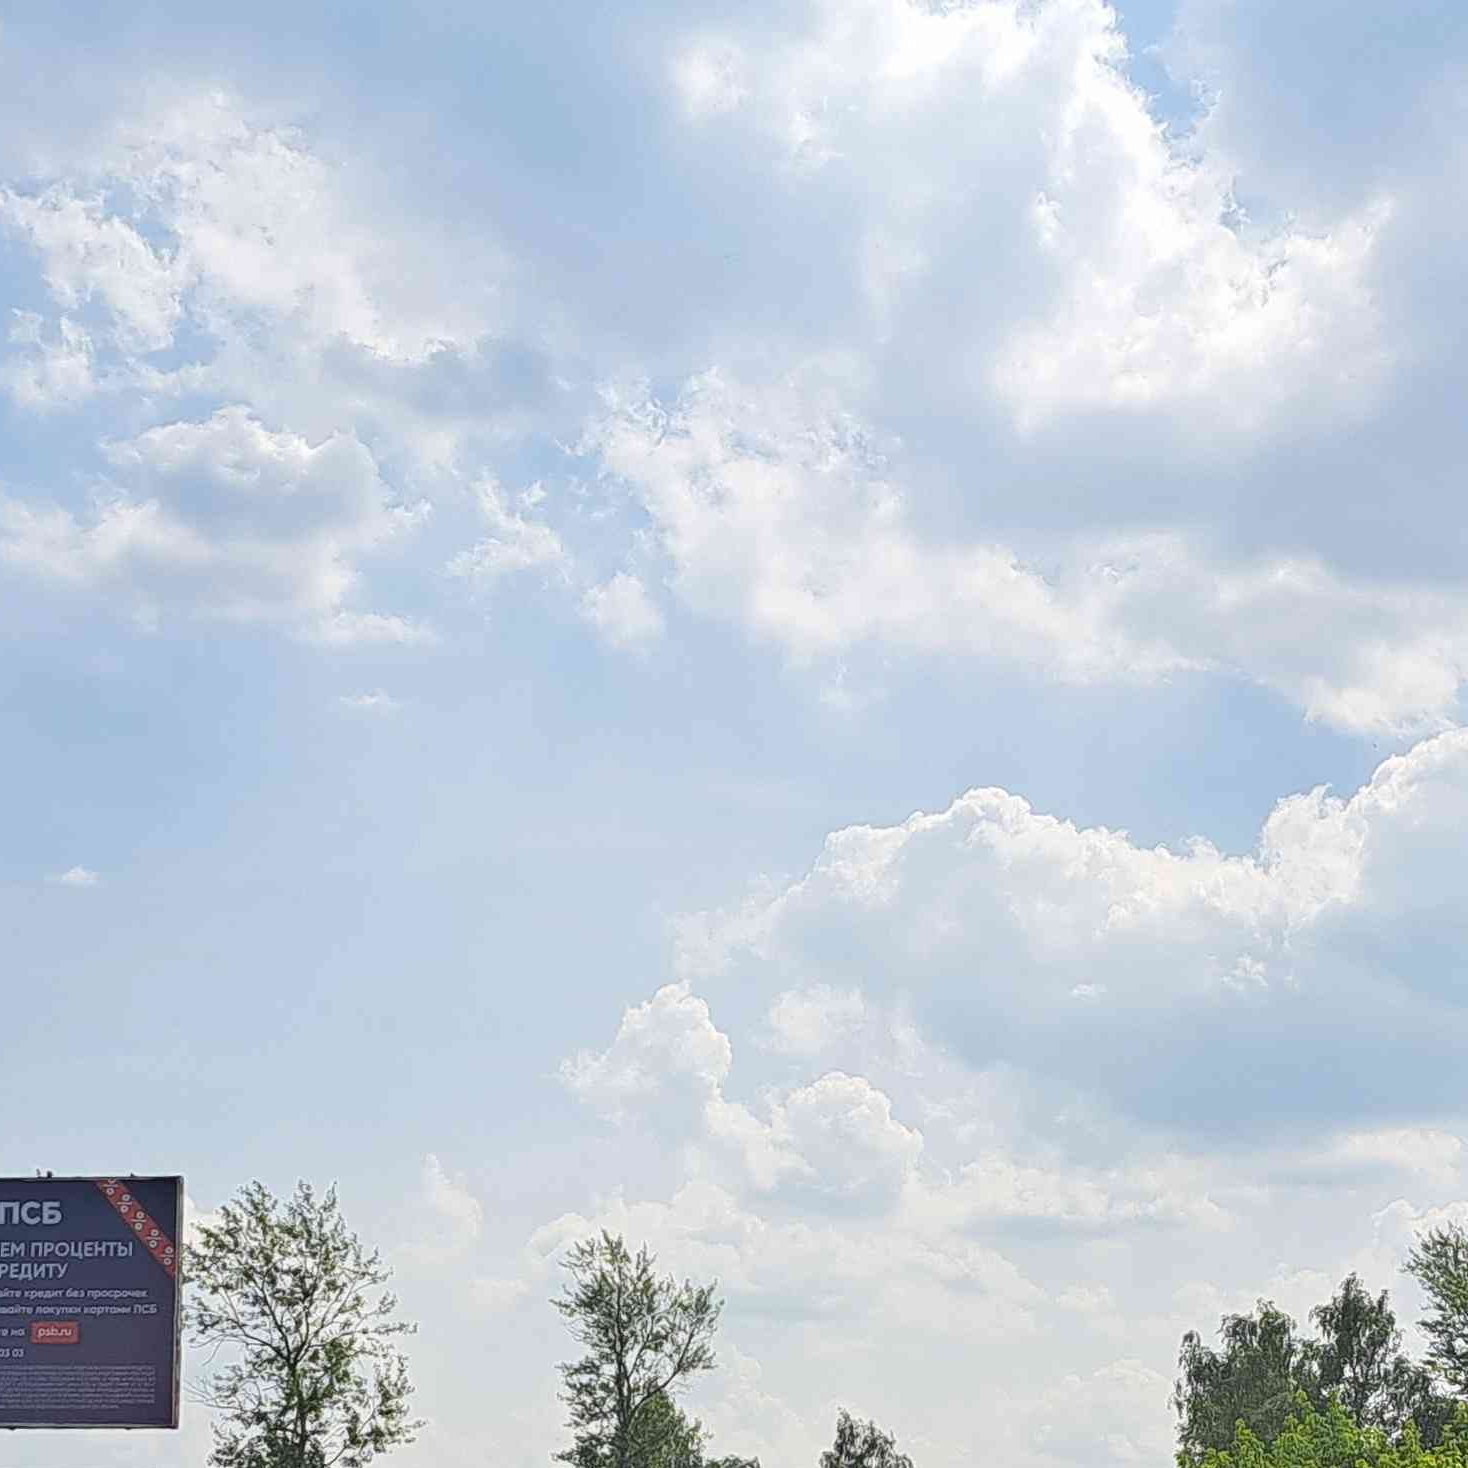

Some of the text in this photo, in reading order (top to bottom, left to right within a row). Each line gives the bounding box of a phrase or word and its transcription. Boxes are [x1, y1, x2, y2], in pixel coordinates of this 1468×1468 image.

[31, 1242, 133, 1260] ПРОЦЕНТЫ
[24, 1289, 63, 1300] кредит
[66, 1288, 85, 1298] без
[133, 1304, 157, 1314] ПСБ
[38, 1326, 72, 1339] psb.ru
